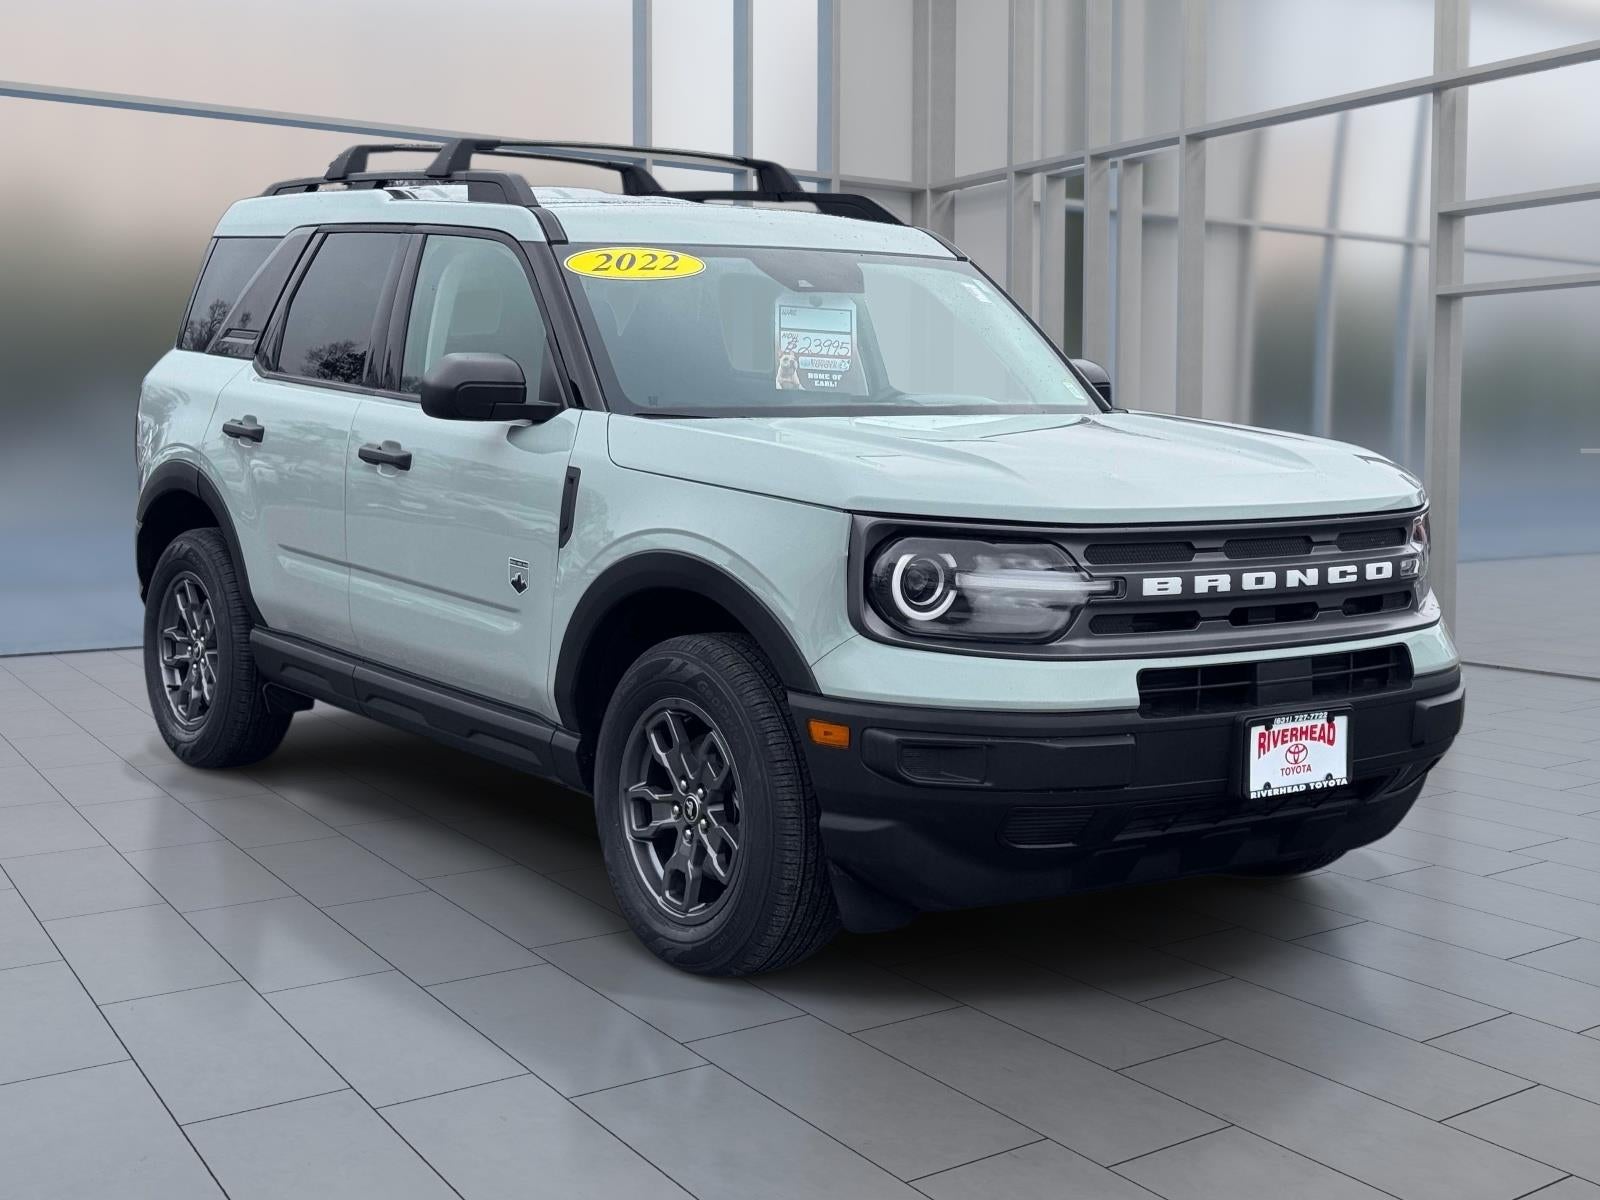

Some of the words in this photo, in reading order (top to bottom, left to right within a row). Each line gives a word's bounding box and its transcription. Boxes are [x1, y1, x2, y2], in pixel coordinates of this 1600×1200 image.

[592, 253, 680, 272] 2022
[807, 372, 830, 380] HOME
[1142, 561, 1393, 596] BRONCO
[1258, 721, 1336, 760] RIVERHEAD
[1280, 764, 1312, 776] TOYOTA
[1250, 783, 1306, 799] RIVERHEAD
[1309, 778, 1348, 790] TOYOTA
